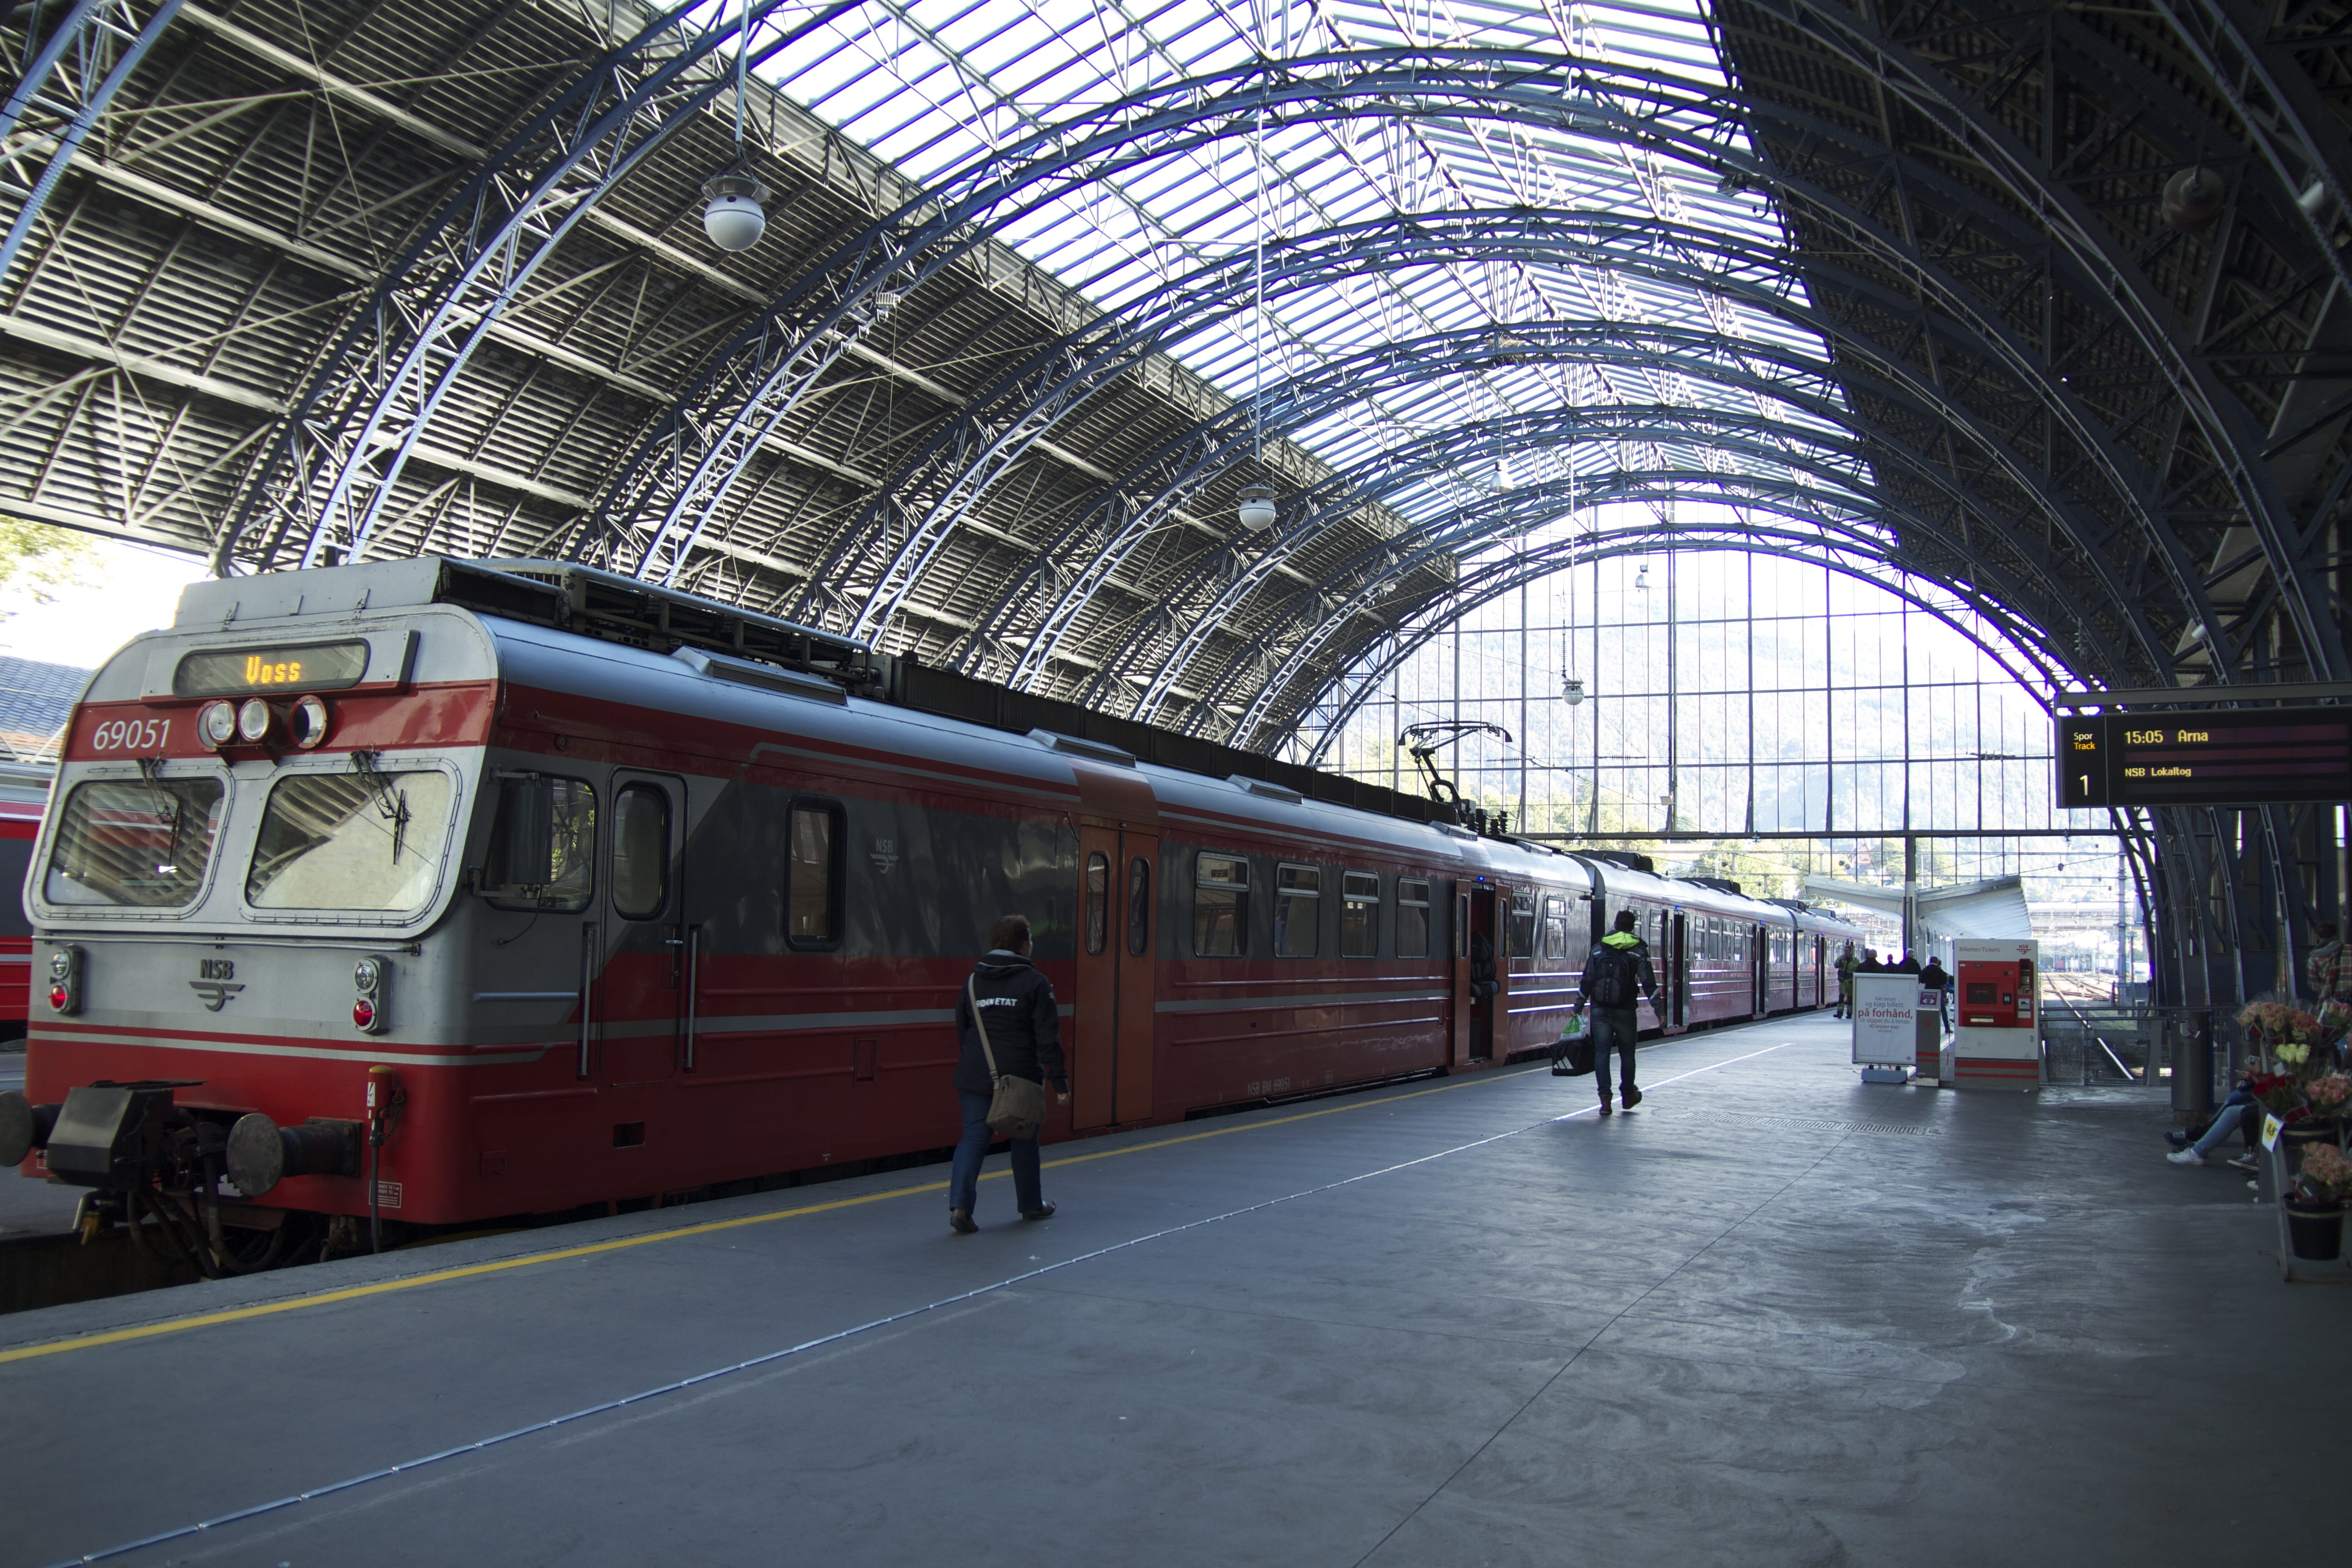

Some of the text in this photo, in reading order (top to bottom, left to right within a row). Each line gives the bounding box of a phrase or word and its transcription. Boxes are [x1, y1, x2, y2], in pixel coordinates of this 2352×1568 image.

[246, 656, 301, 684] Voss
[93, 718, 171, 751] 69051
[2073, 732, 2093, 742] Spor
[2124, 729, 2209, 744] 15:05 Arna
[2073, 742, 2096, 750] Track
[2125, 767, 2191, 777] NSB Lokaltog
[2080, 774, 2088, 796] 1
[876, 838, 893, 853] NSB
[200, 959, 234, 980] NSB
[1858, 1007, 1913, 1019] på forhånd,
[1247, 1081, 1260, 1096] NSB
[1262, 1079, 1271, 1094] BM
[1274, 1077, 1291, 1092] 69051
